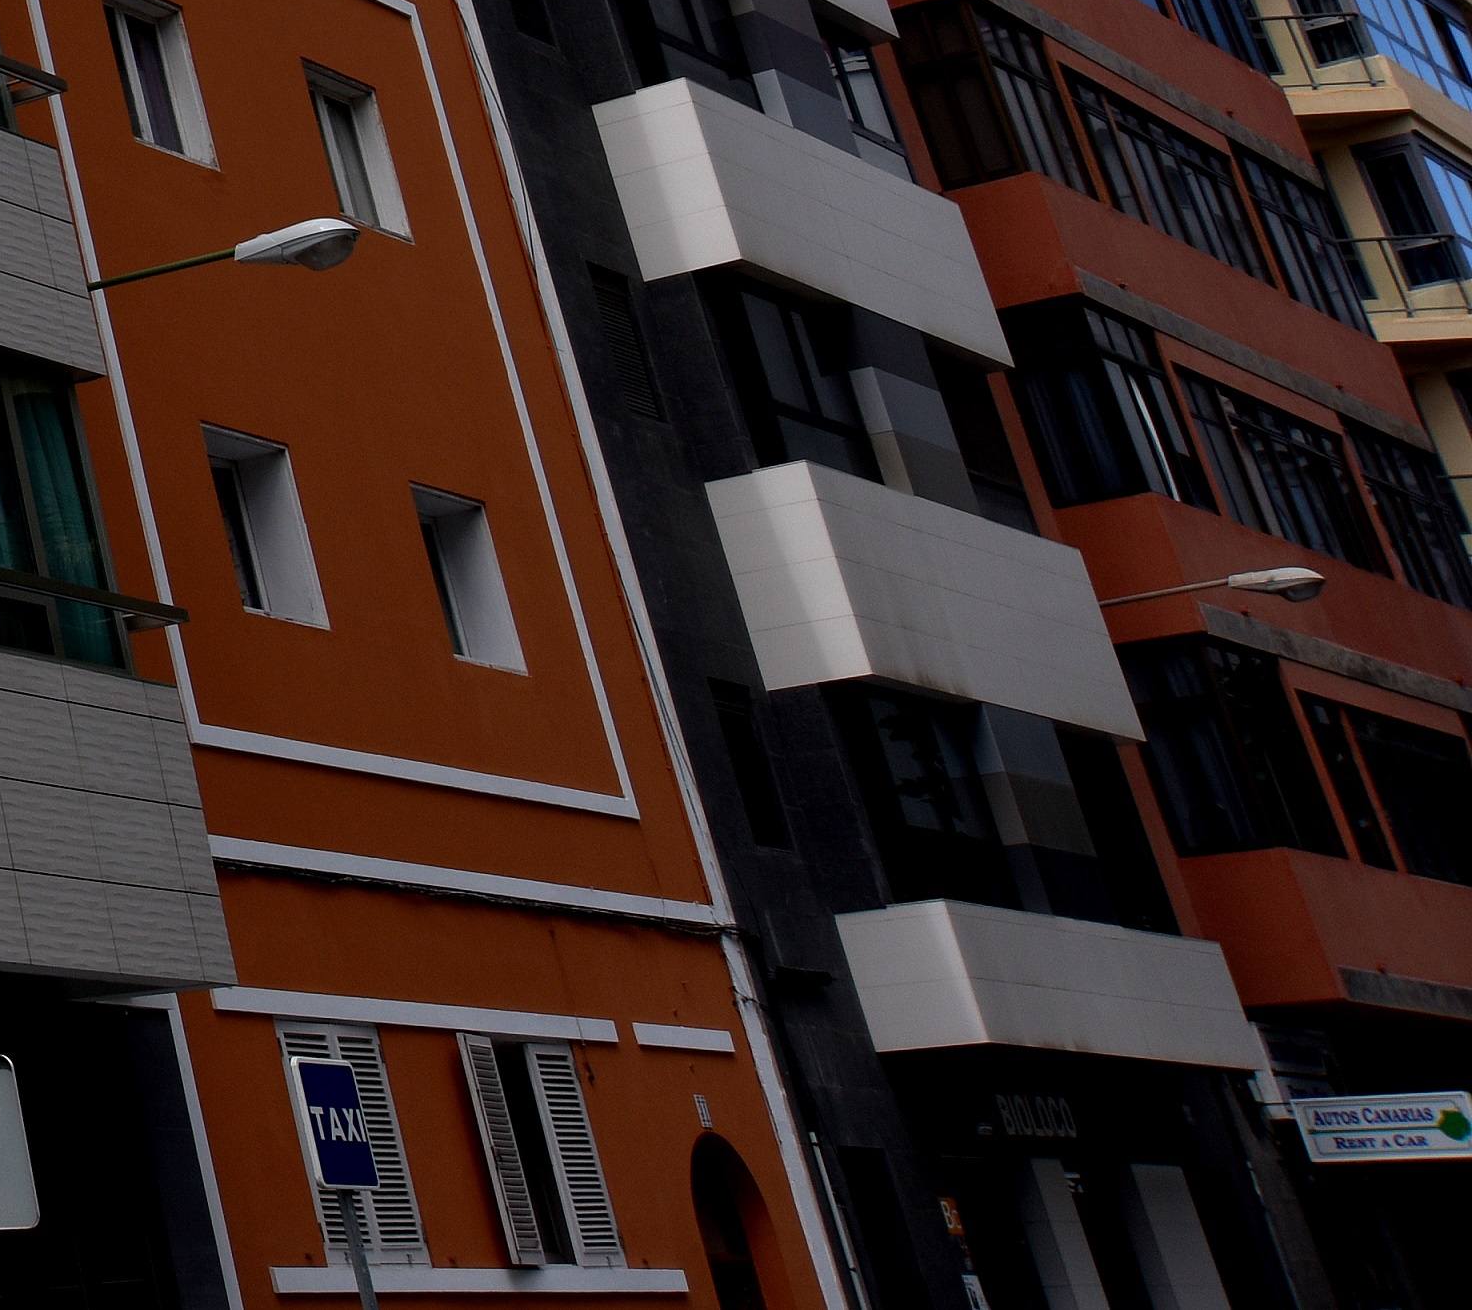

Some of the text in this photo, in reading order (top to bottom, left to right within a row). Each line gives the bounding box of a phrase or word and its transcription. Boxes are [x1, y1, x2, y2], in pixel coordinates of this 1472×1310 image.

[309, 1106, 368, 1143] TAXI
[1314, 1108, 1434, 1126] AUTOS CANARIAS
[1335, 1135, 1428, 1149] RENT A CAR
